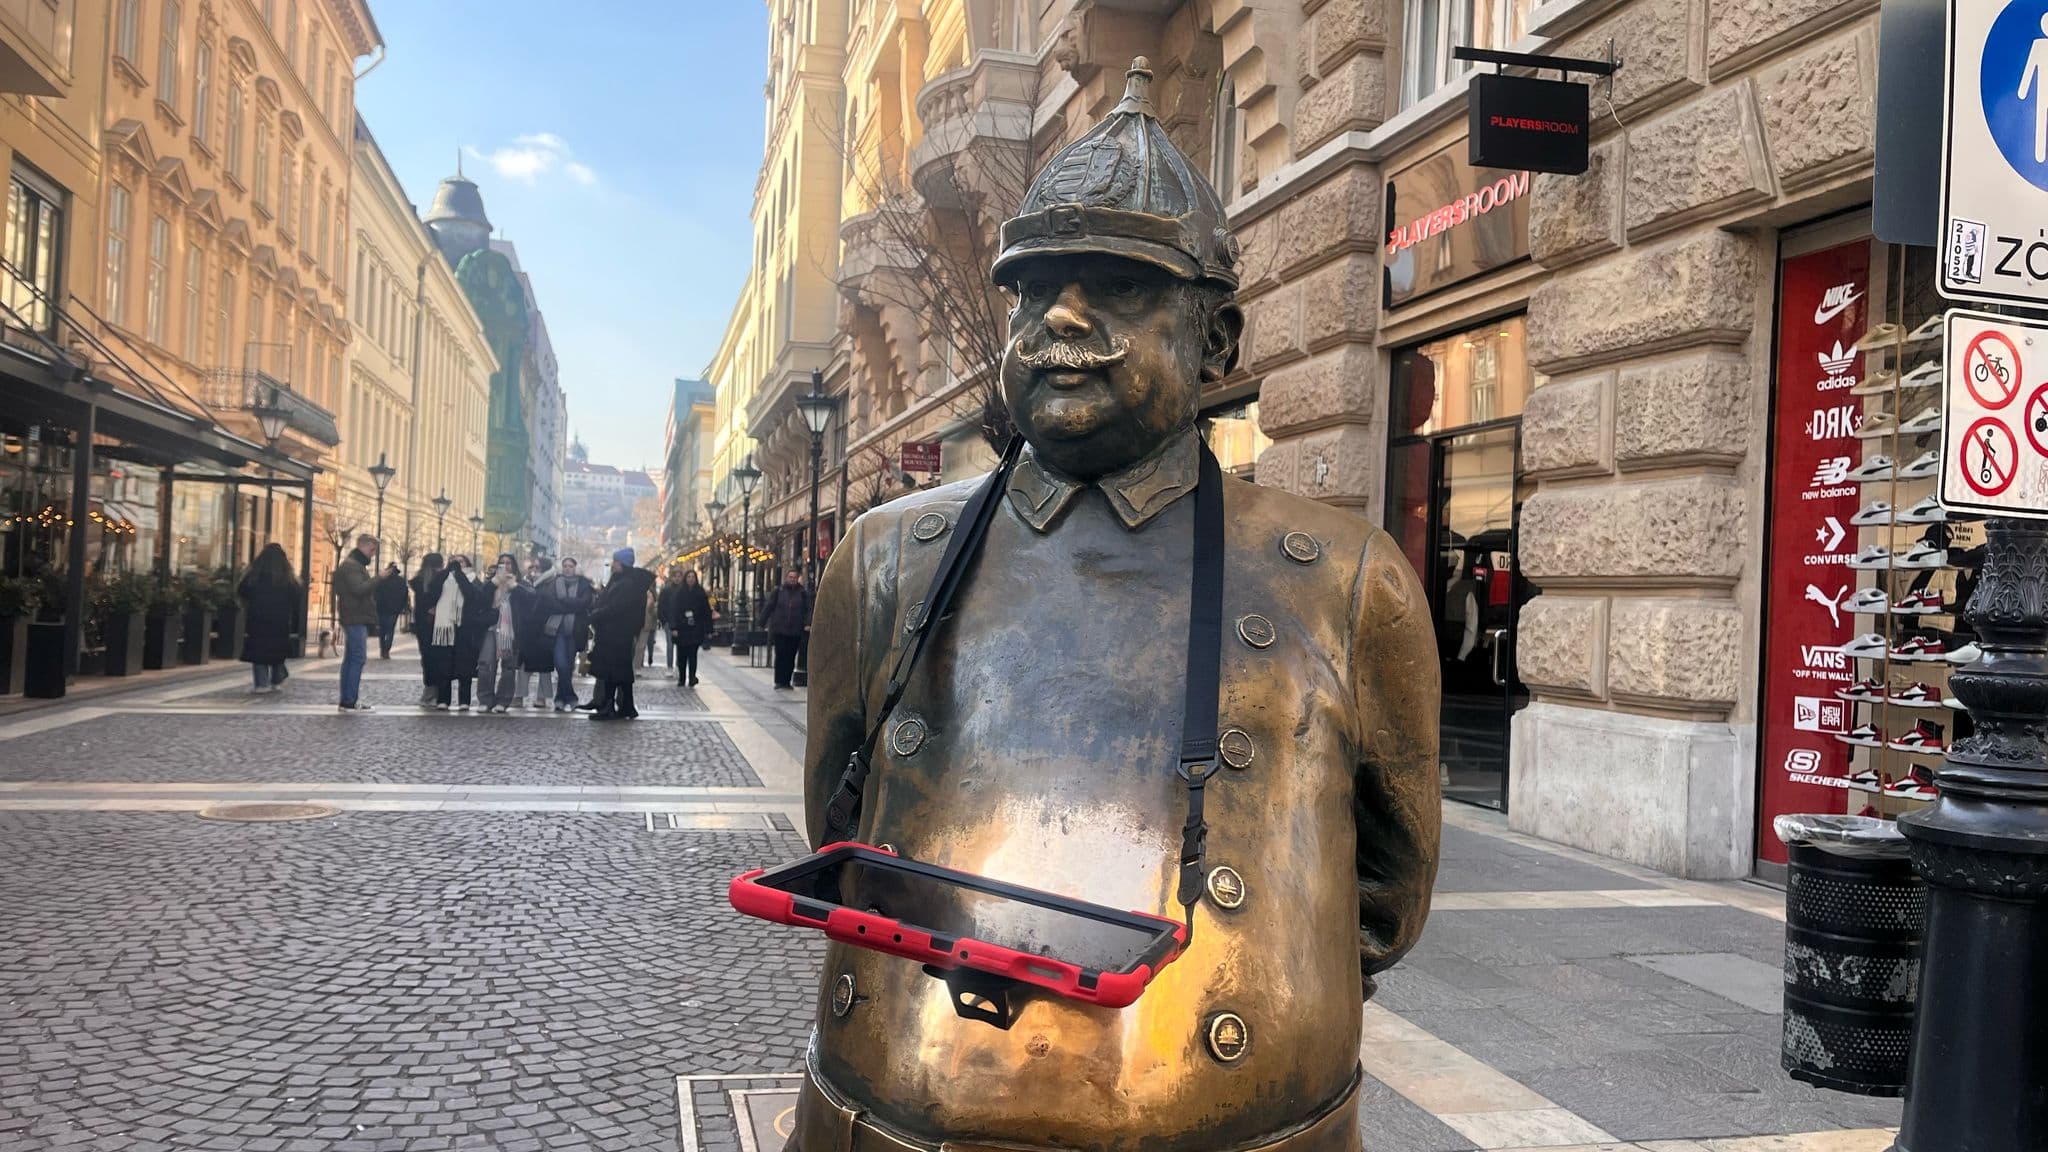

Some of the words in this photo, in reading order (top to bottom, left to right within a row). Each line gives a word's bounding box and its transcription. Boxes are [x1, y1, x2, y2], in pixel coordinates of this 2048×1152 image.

[1490, 116, 1579, 135] PLAYERSROOM
[1387, 170, 1531, 254] PLAYERSROOM
[1952, 223, 1963, 277] 21052
[1822, 282, 1855, 309] NIKE
[1816, 375, 1856, 391] adidas
[1802, 490, 1819, 500] new
[1820, 486, 1856, 498] balance
[1804, 554, 1857, 565] CONVERSE
[1801, 645, 1847, 669] VANS
[1812, 670, 1827, 680] THE
[1821, 705, 1840, 717] NEW
[1821, 716, 1840, 727] ERA
[1789, 773, 1850, 788] SKECHERS
